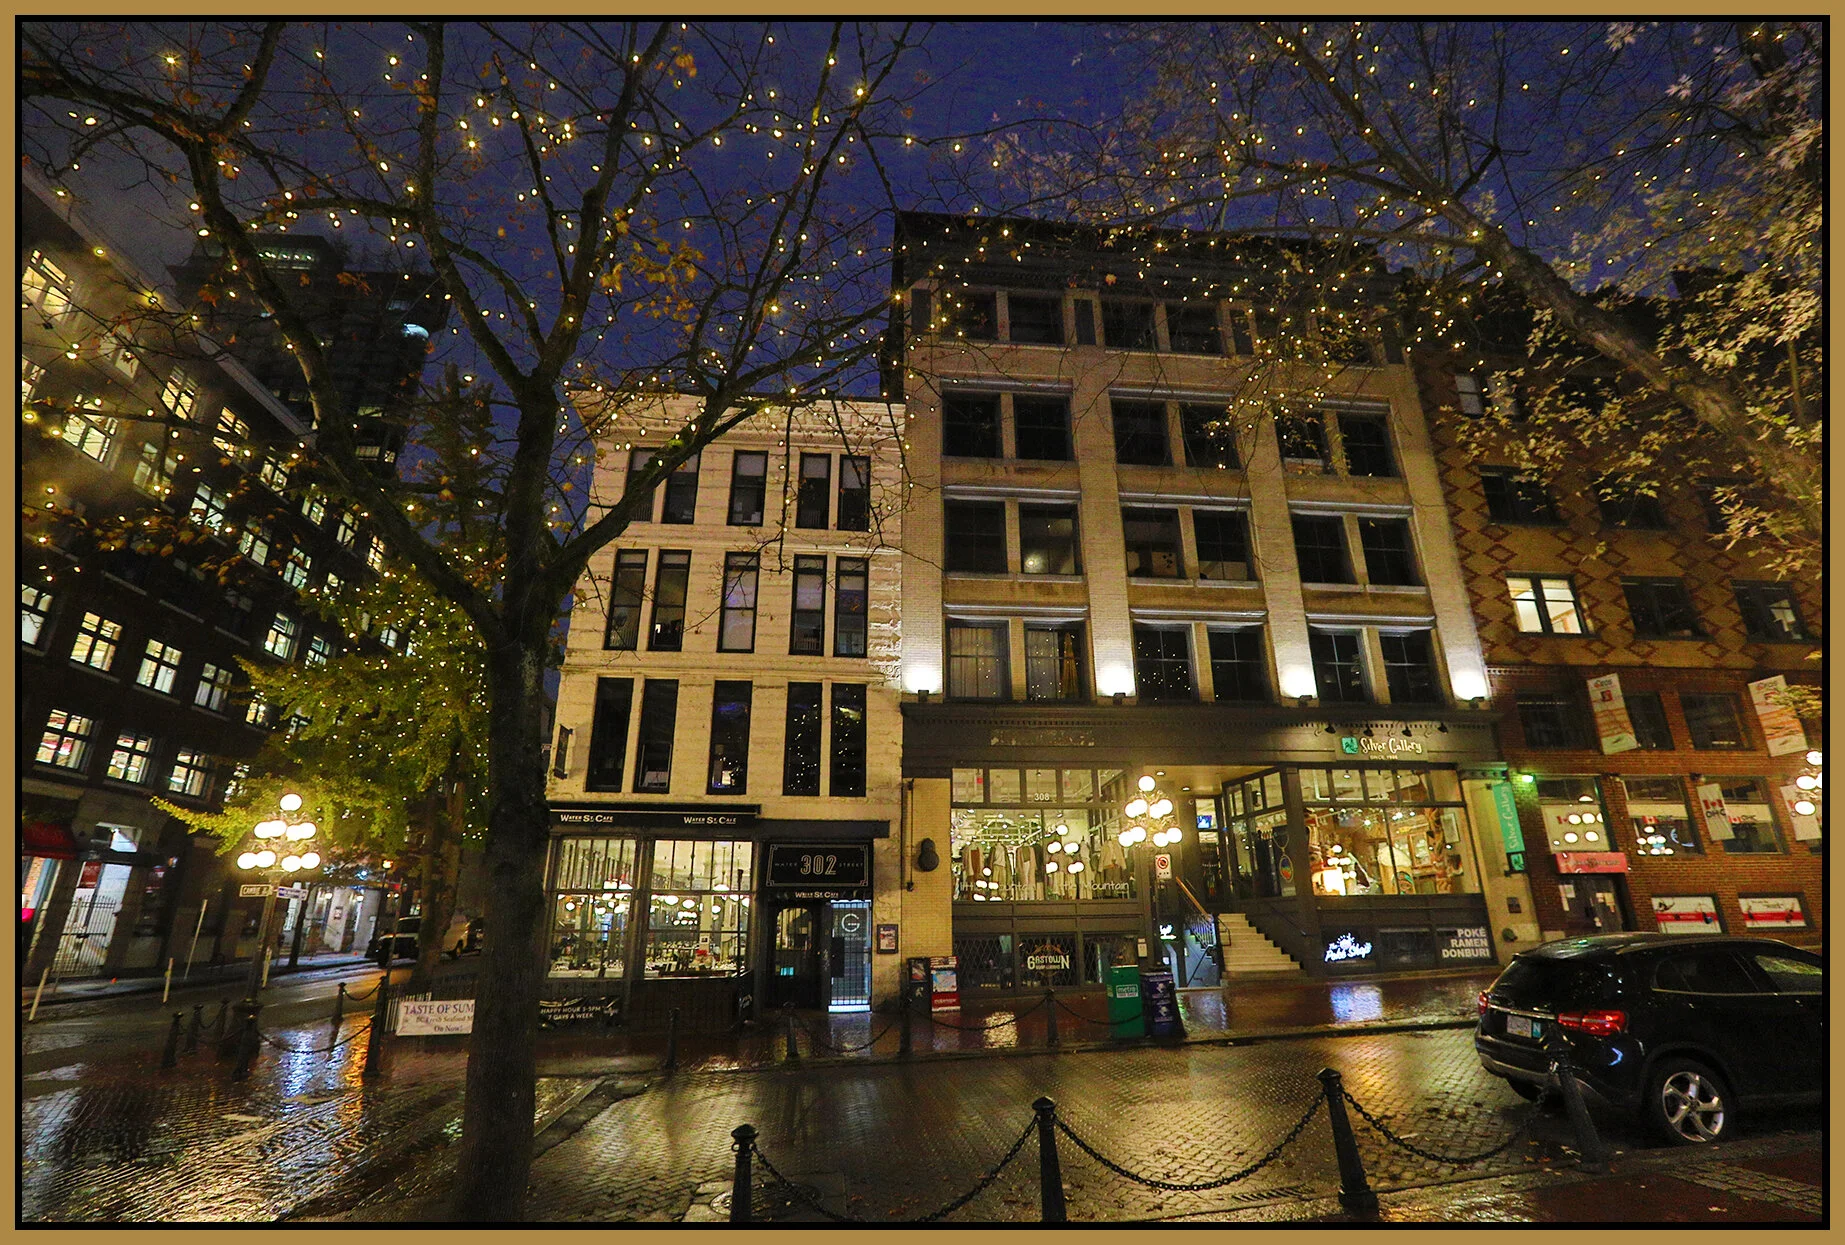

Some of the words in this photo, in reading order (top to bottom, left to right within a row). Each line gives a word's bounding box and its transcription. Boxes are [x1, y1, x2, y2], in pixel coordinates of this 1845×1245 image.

[1360, 737, 1387, 754] Silver
[1388, 737, 1422, 754] Gallery
[1034, 793, 1050, 801] 308
[800, 855, 837, 875] 302
[1450, 938, 1488, 948] RAMEN
[1441, 948, 1490, 959] DONBURI
[404, 1005, 434, 1015] TASTE
[436, 1004, 451, 1015] OF
[1533, 1022, 1541, 1032] N
